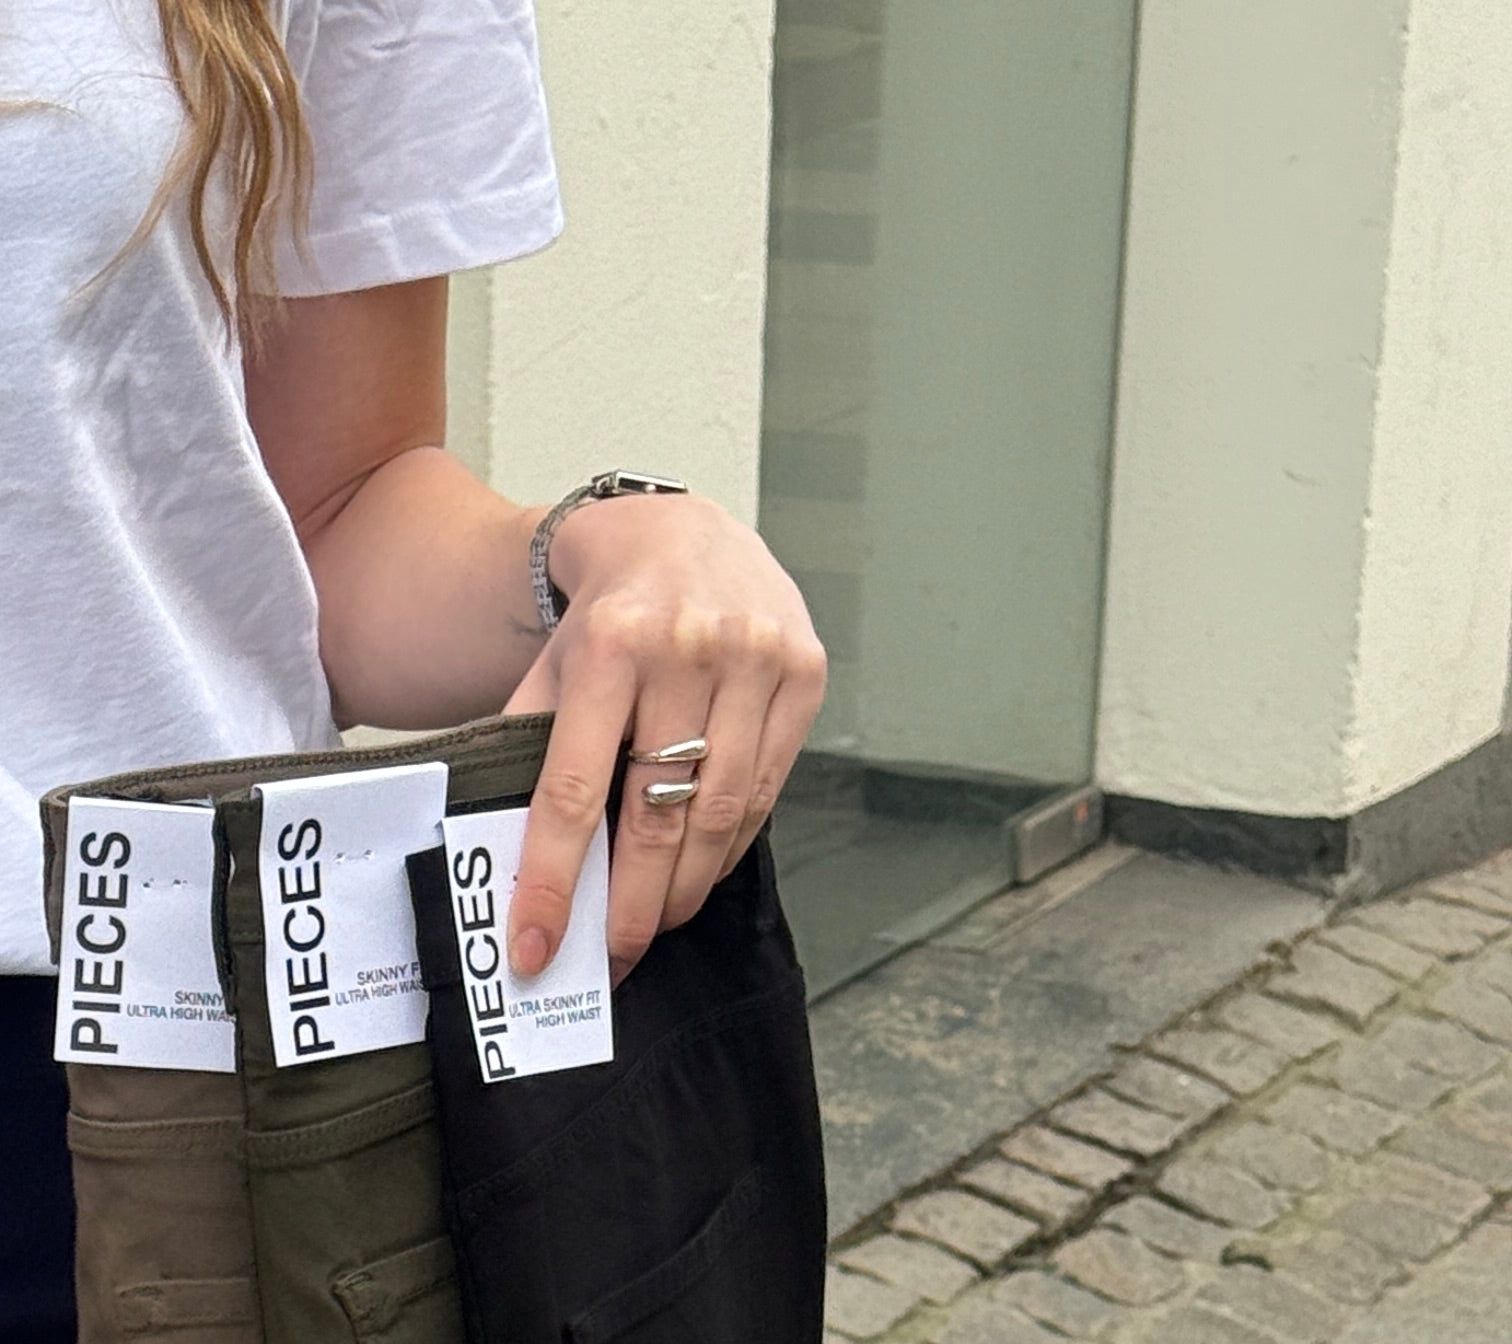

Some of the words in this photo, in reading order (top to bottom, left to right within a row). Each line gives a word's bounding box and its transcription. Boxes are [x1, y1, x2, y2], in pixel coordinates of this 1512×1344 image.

[70, 831, 131, 1054] PIECES
[278, 818, 335, 1057] PIECES
[357, 963, 408, 986] SKINNY
[453, 847, 516, 1079] PIECES
[174, 990, 224, 1007] SKINNY
[334, 987, 370, 1006] ULTRA
[370, 982, 397, 998] HIGH
[508, 1000, 541, 1019] ULTRA
[542, 992, 584, 1012] SKINNY
[586, 989, 600, 1006] FIT
[127, 1003, 167, 1019] ULTRA
[169, 1006, 203, 1022] HIGH
[535, 1012, 565, 1029] HIGH
[566, 1006, 601, 1024] WAIST
